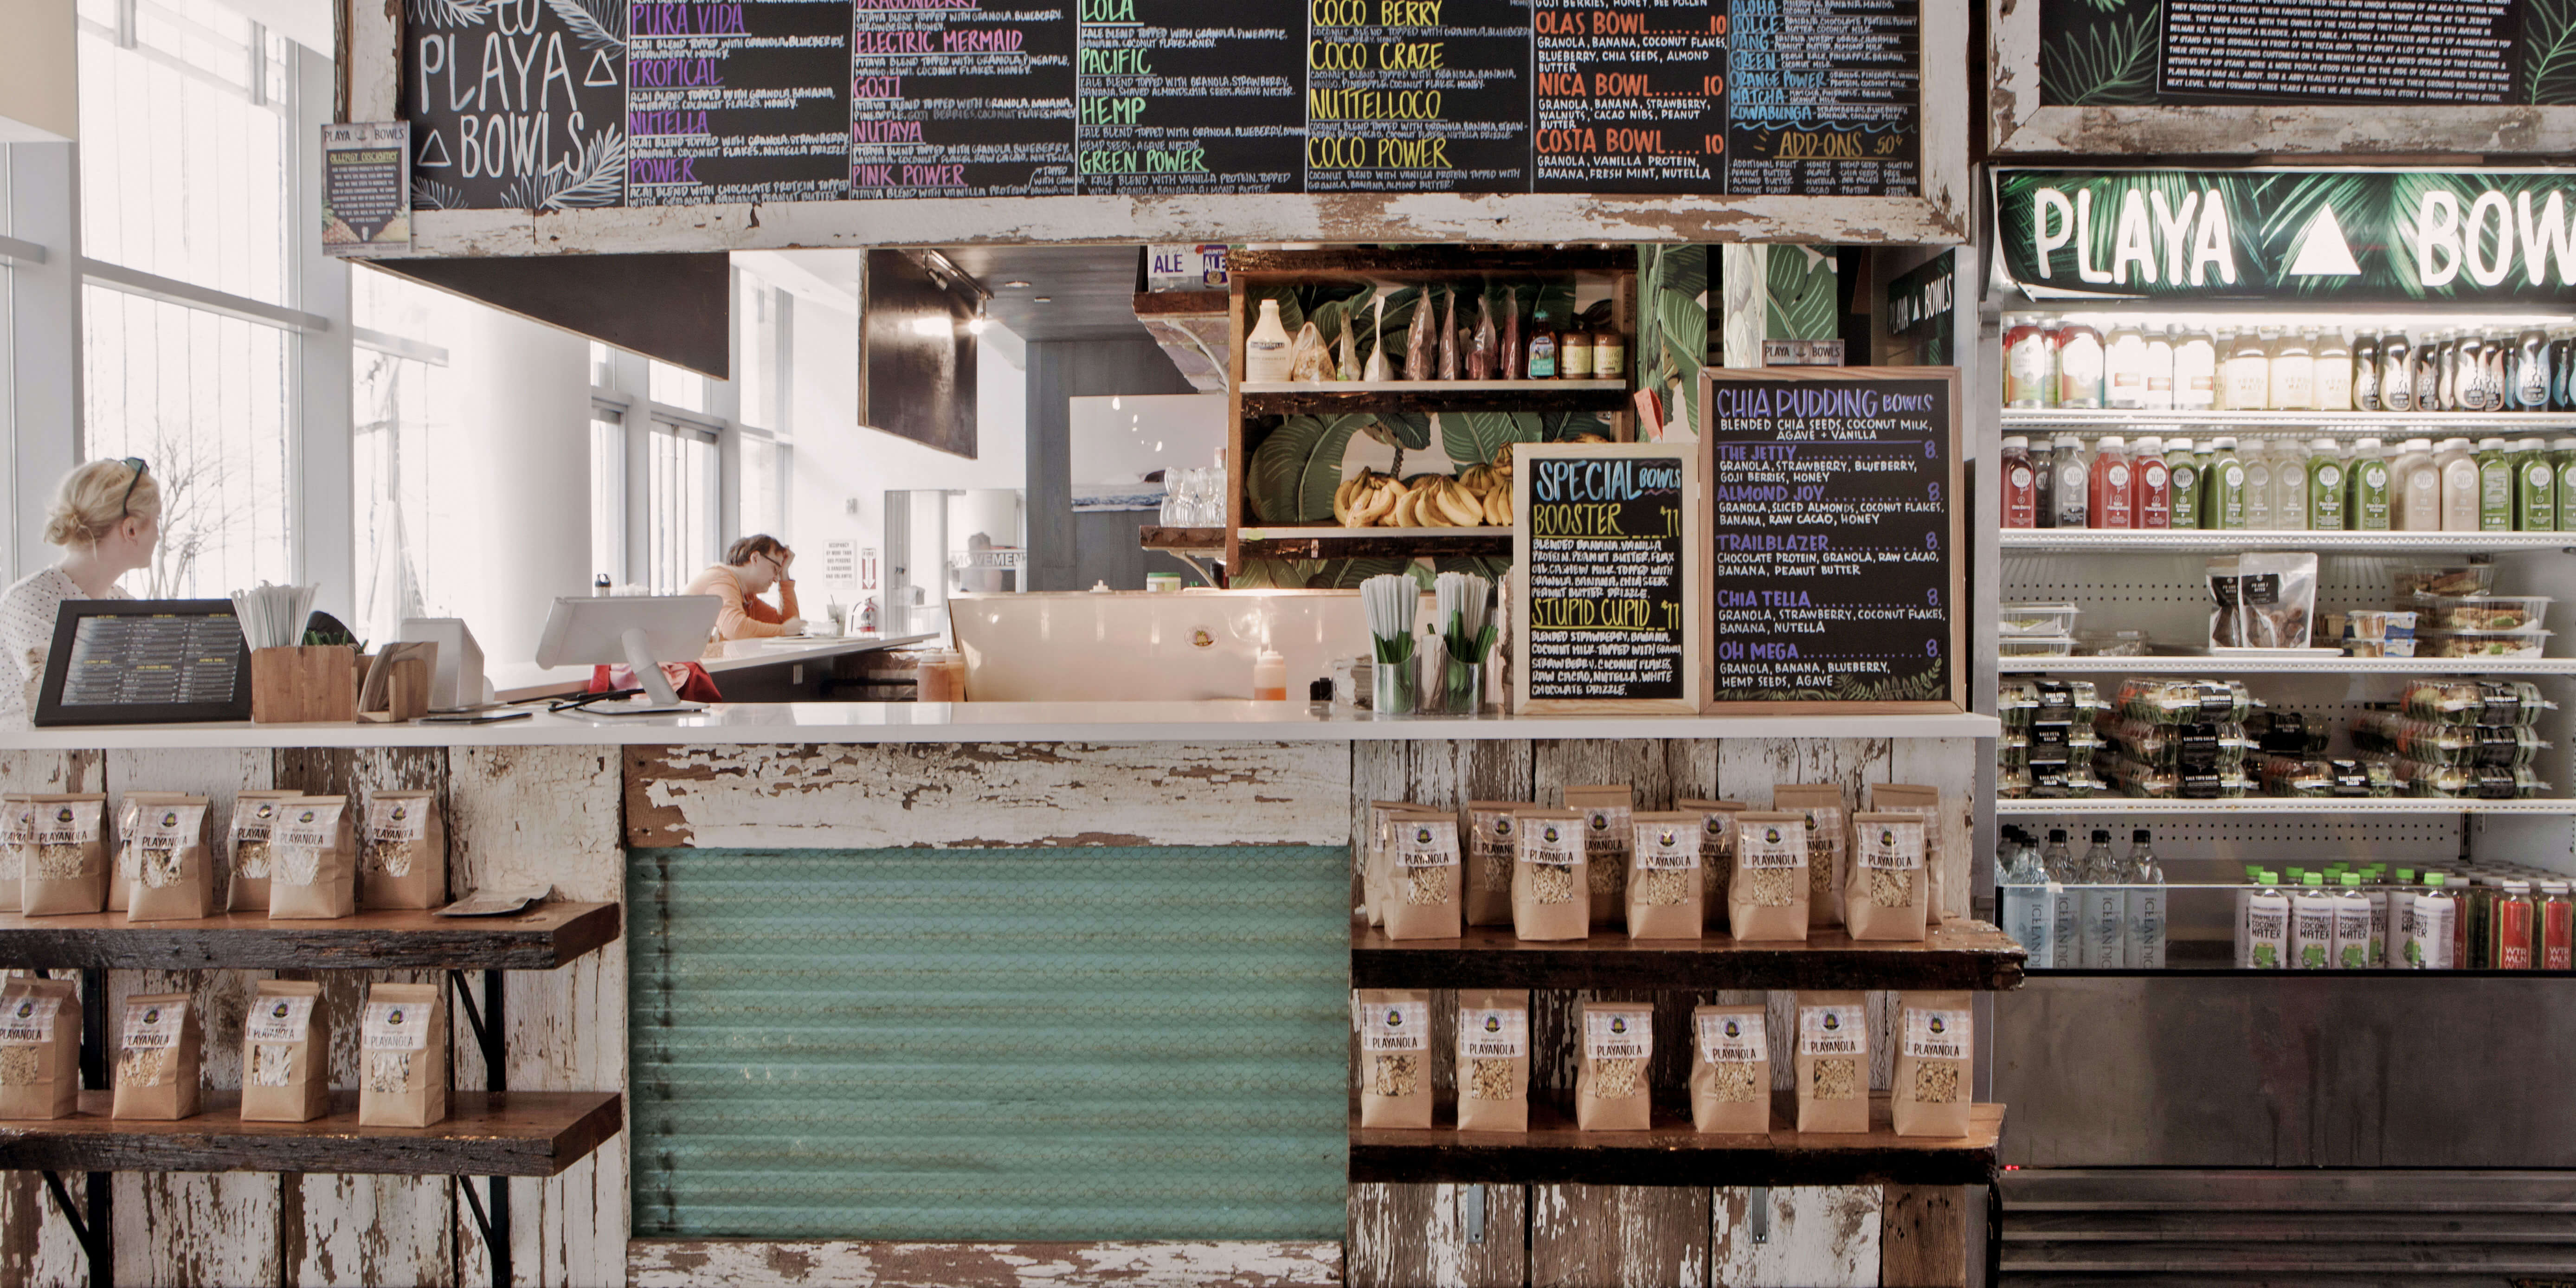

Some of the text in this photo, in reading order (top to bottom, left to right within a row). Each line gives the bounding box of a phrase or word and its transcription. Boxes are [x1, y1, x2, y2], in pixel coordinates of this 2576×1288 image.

[1082, 0, 1135, 21] LOLA
[1312, 0, 1441, 26] COCO BERRY
[631, 3, 746, 35] PURA VIDA
[1536, 11, 1585, 35] OLAS
[857, 28, 1023, 54] ELECTRIC MERMAID
[1538, 36, 1727, 51] GRANOLA, BANANA, COCONUT FLAKES,
[1081, 47, 1151, 74] PACIFIC
[1310, 40, 1444, 70] COCO CRAZE
[1539, 50, 1709, 64] BLUEBERRY, CHIA SEEDS, ALMOND
[421, 32, 577, 114] PLAYA
[630, 58, 724, 87] TROPICAL
[1539, 62, 1577, 73] BUTTER
[854, 76, 901, 98] GOJI
[1539, 73, 1586, 97] NICA
[1729, 71, 1780, 88] ORANGE
[1081, 97, 1146, 124] HEMP
[1310, 88, 1441, 120] NUTTELLOCO
[630, 110, 709, 135] NUTELLA
[325, 129, 404, 142] PLAYA BOWLS
[853, 121, 923, 142] NUTAYA
[461, 111, 584, 178] BOWLS
[1536, 129, 1596, 154] COSTA
[1780, 131, 1863, 157] ADD-ONS
[1308, 136, 1452, 168] COCO POWER
[1080, 148, 1210, 174] GREEN POWER
[1538, 156, 1700, 167] GRANOLA, VANILLA PROTEIN,
[630, 158, 697, 183] POWER
[853, 164, 968, 186] PINK POWER
[1347, 171, 1372, 180] BLEND
[1376, 171, 1396, 180] WITH
[1400, 170, 1432, 179] VANILLA
[1538, 168, 1711, 181] BANANA, FRESH MINT, NUTELLA
[1091, 174, 1217, 185] KALE BLEND WITH VANILLA
[919, 188, 941, 198] WITH
[2034, 187, 2236, 287] PLAYA
[1154, 255, 1183, 273] ALE
[1204, 256, 1226, 272] ALE
[1925, 272, 1952, 320] BOWLS
[1765, 346, 1840, 357] PLAYA BOWLS
[1717, 388, 1934, 418] CHIA PUDDING BOWLS
[1720, 419, 1932, 432] BLENDED CHIA SEEDS, COCONUT MILK,
[1777, 431, 1877, 441] AGAVE VANILLA
[1717, 446, 1746, 460] THE
[1719, 461, 1917, 473] GRANOLA, STRAWBERRY, BLUEBERRY,
[1537, 460, 1681, 502] SPECIAL BOWLS
[1720, 472, 1830, 484] GOJI BERRIES, HONEY
[1717, 486, 1788, 502] ALMOND
[1534, 502, 1624, 535] BOOSTER
[1717, 552, 1939, 565] CHOCOLATE PROTEIN, GRANOLA, RAW CACAO,
[1718, 565, 1861, 577] BANANA, PEANUT BUTTER
[1717, 590, 1758, 607] CHIA
[1532, 599, 1594, 626] STUPID
[1601, 599, 1651, 626] CUPID
[1719, 641, 1799, 660] OH MEGA
[39, 830, 88, 844] PLAYANOLA
[142, 834, 188, 848] PLAYANOLA
[1405, 852, 1449, 865] PLAYANOLA
[1530, 850, 1573, 863] PLAYANOLA
[1752, 854, 1798, 866] PLAYANOLA
[1868, 856, 1912, 867] PLAYANOLA
[2252, 929, 2281, 939] WATER
[2300, 929, 2329, 940] WATER
[2340, 929, 2367, 940] WATER
[2505, 947, 2526, 955] WTR
[2549, 947, 2569, 955] WTR
[124, 1034, 170, 1046] PLAYANOLA
[1373, 1037, 1418, 1049] PLAYANOLA
[1811, 1041, 1856, 1053] PLAYANOLA
[1469, 1044, 1515, 1056] PLAYANOLA
[1597, 1045, 1642, 1057] PLAYANOLA
